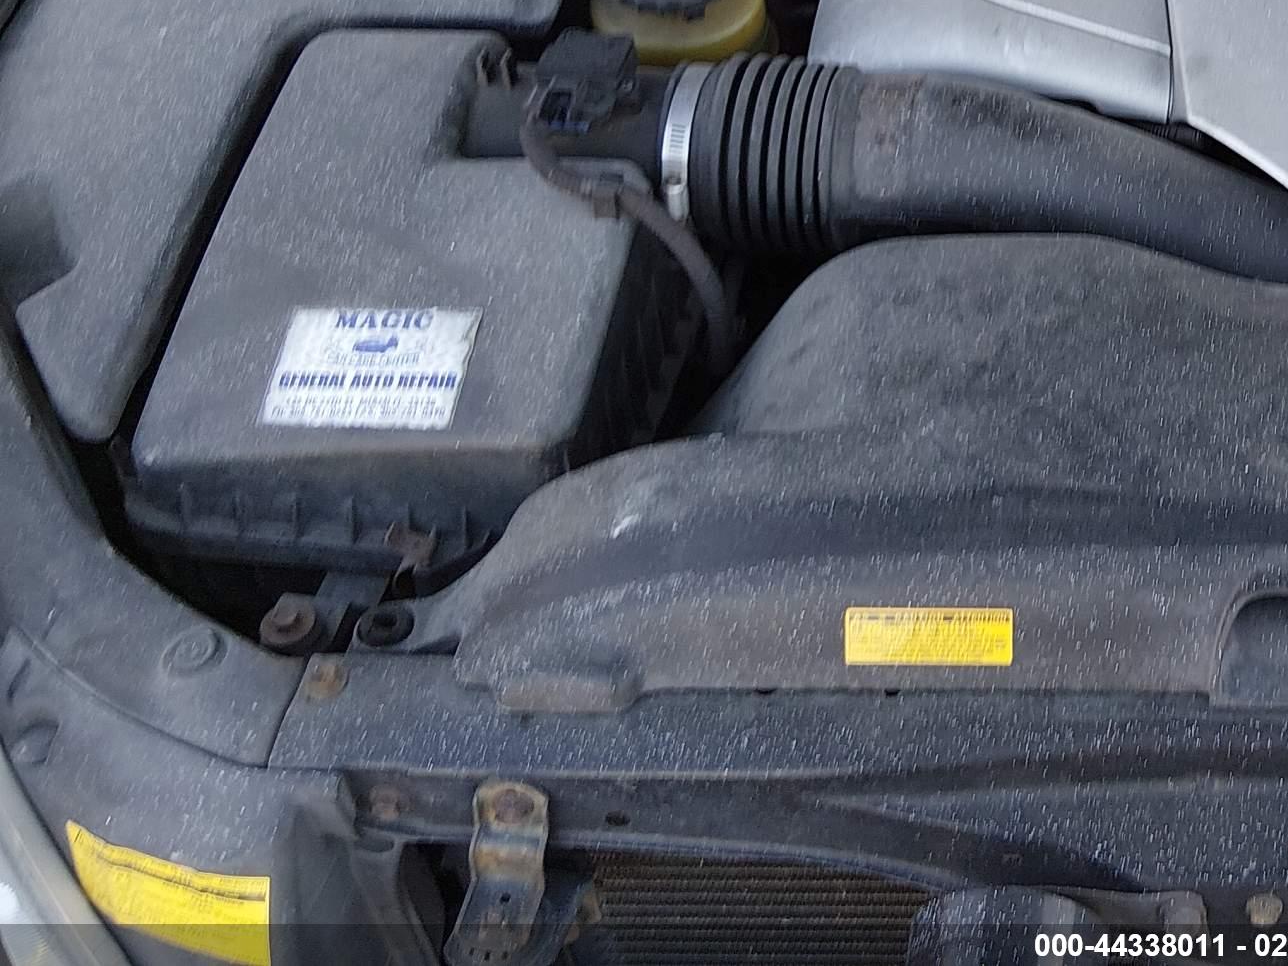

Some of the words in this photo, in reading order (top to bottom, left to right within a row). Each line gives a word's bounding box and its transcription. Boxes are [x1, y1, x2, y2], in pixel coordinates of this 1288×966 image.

[335, 309, 434, 329] MAGIC
[279, 371, 347, 389] GENERAL
[350, 371, 394, 389] AUTO
[397, 371, 458, 389] REPAIR
